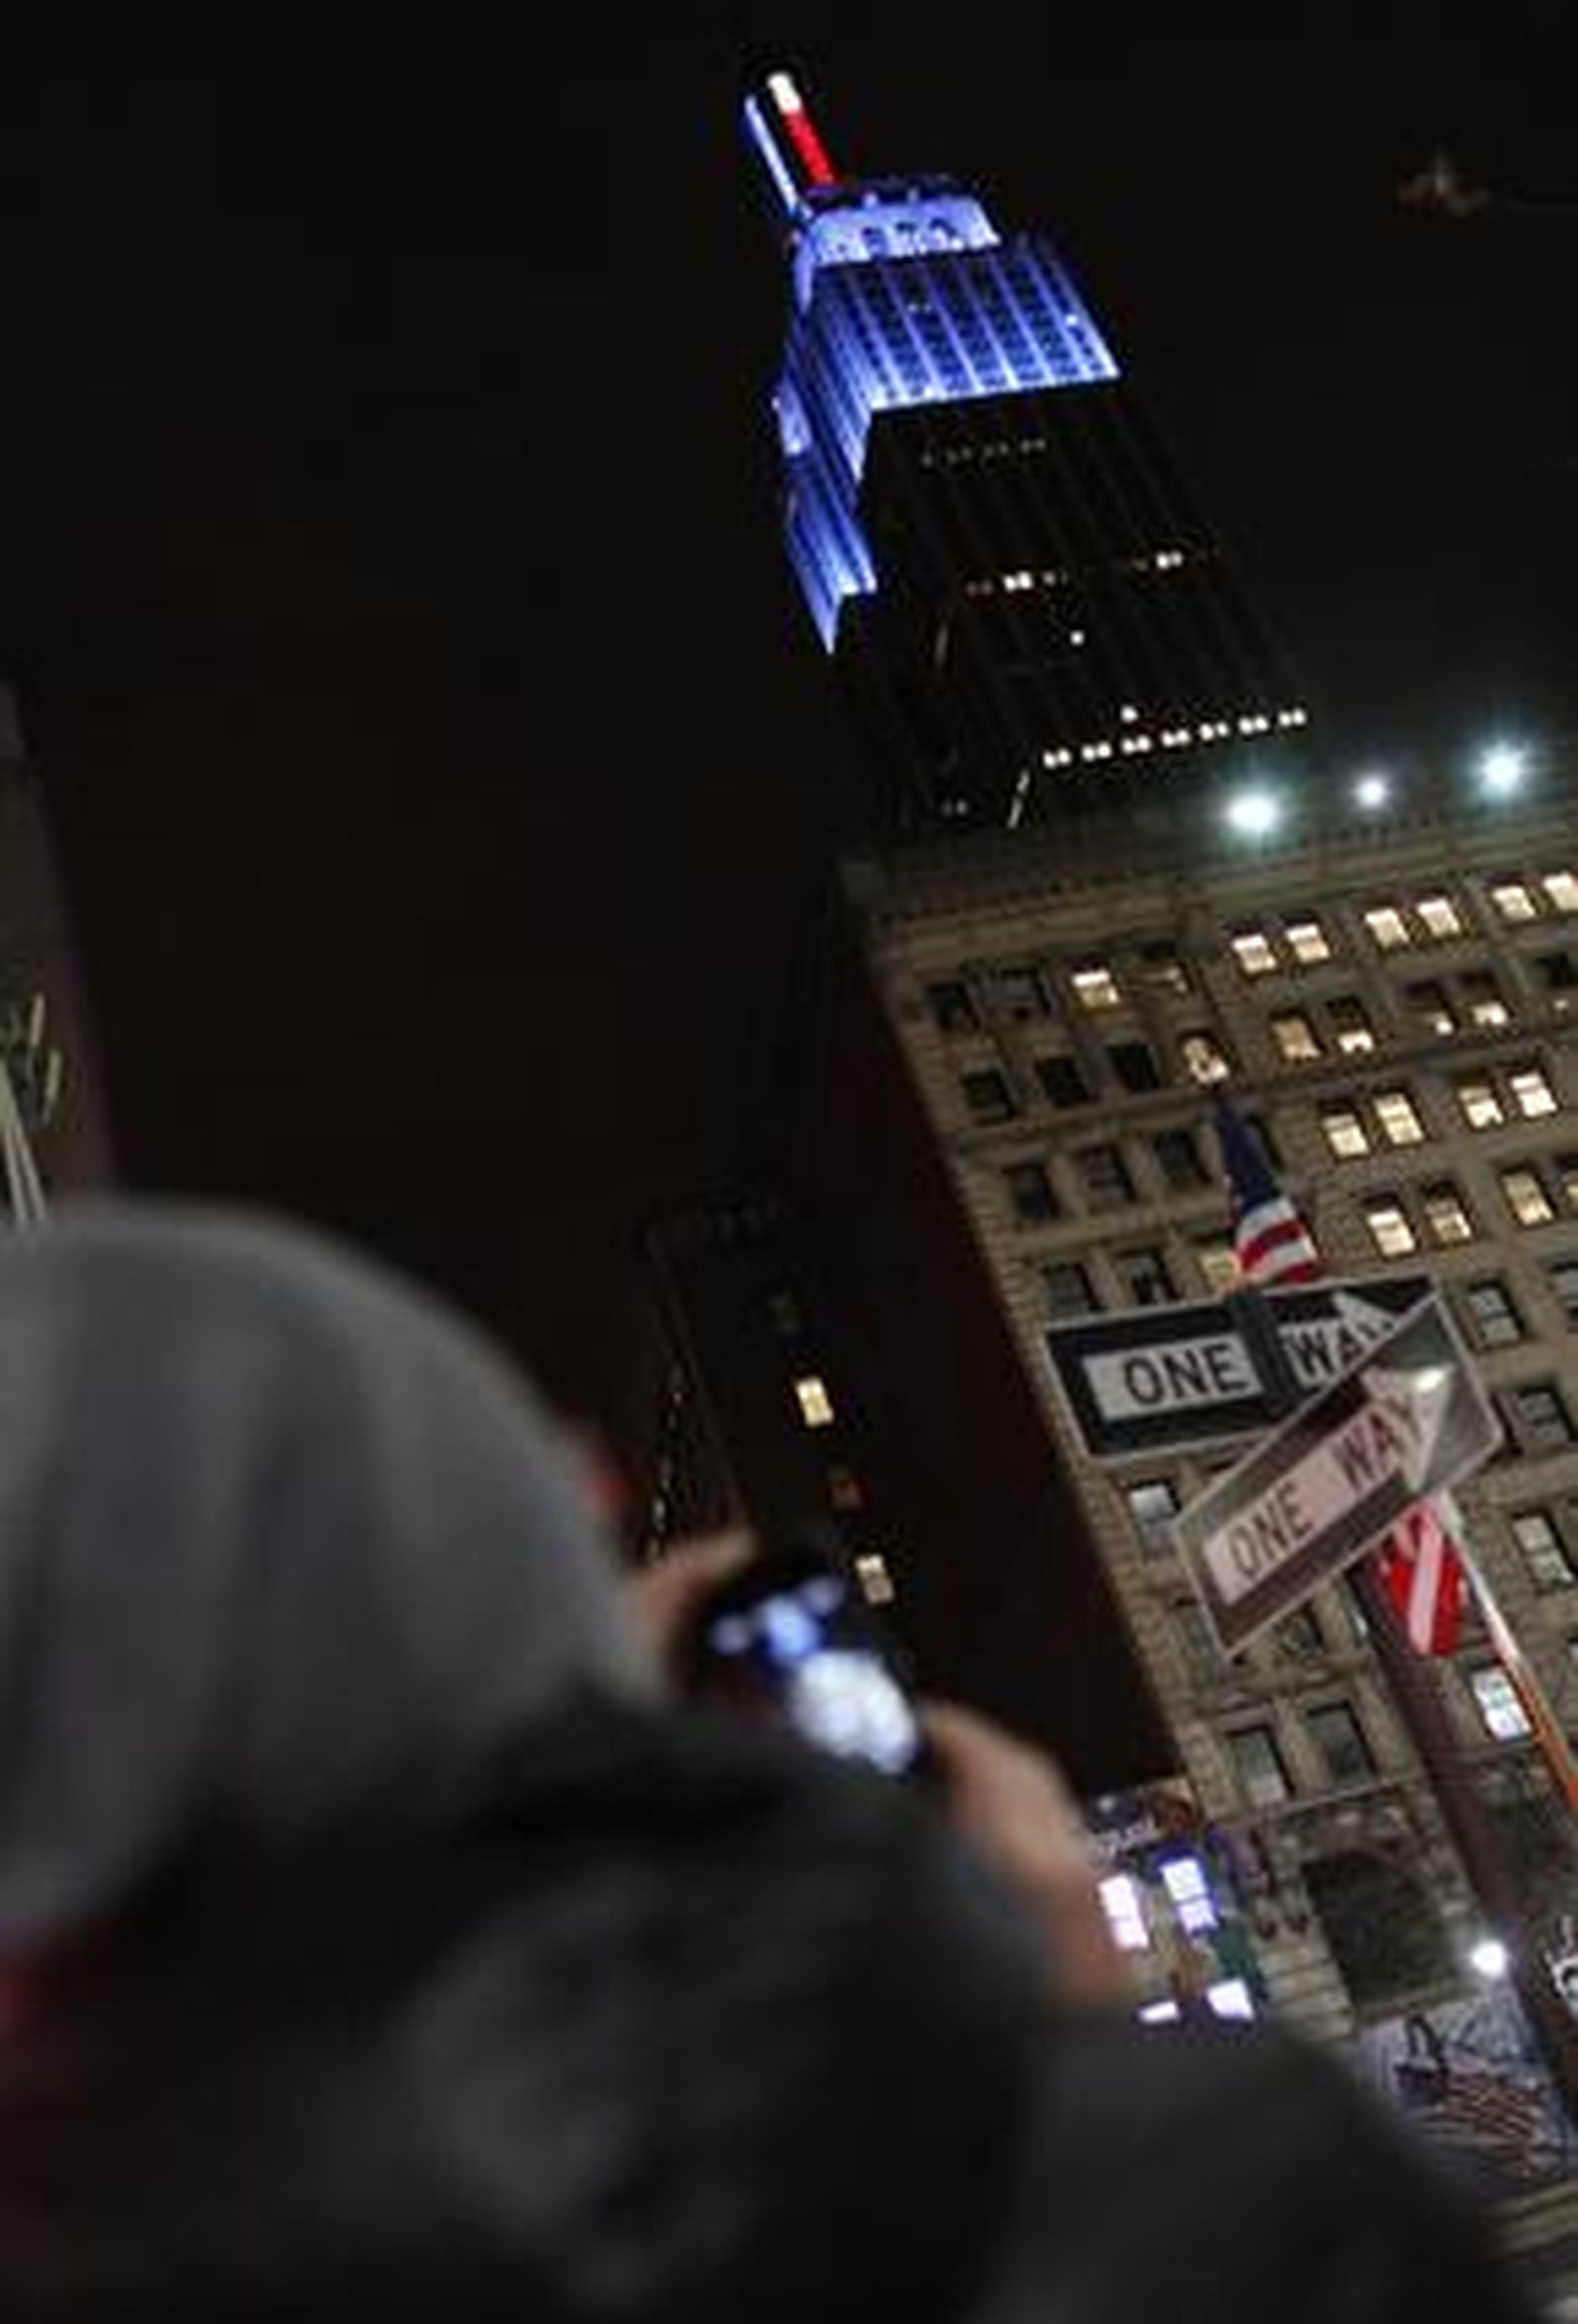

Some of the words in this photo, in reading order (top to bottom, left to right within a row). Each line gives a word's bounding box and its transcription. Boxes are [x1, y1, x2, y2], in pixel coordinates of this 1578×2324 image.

[1123, 1343, 1249, 1406] ONE
[1229, 1483, 1313, 1579] ONE
[1331, 1392, 1422, 1490] WAY
